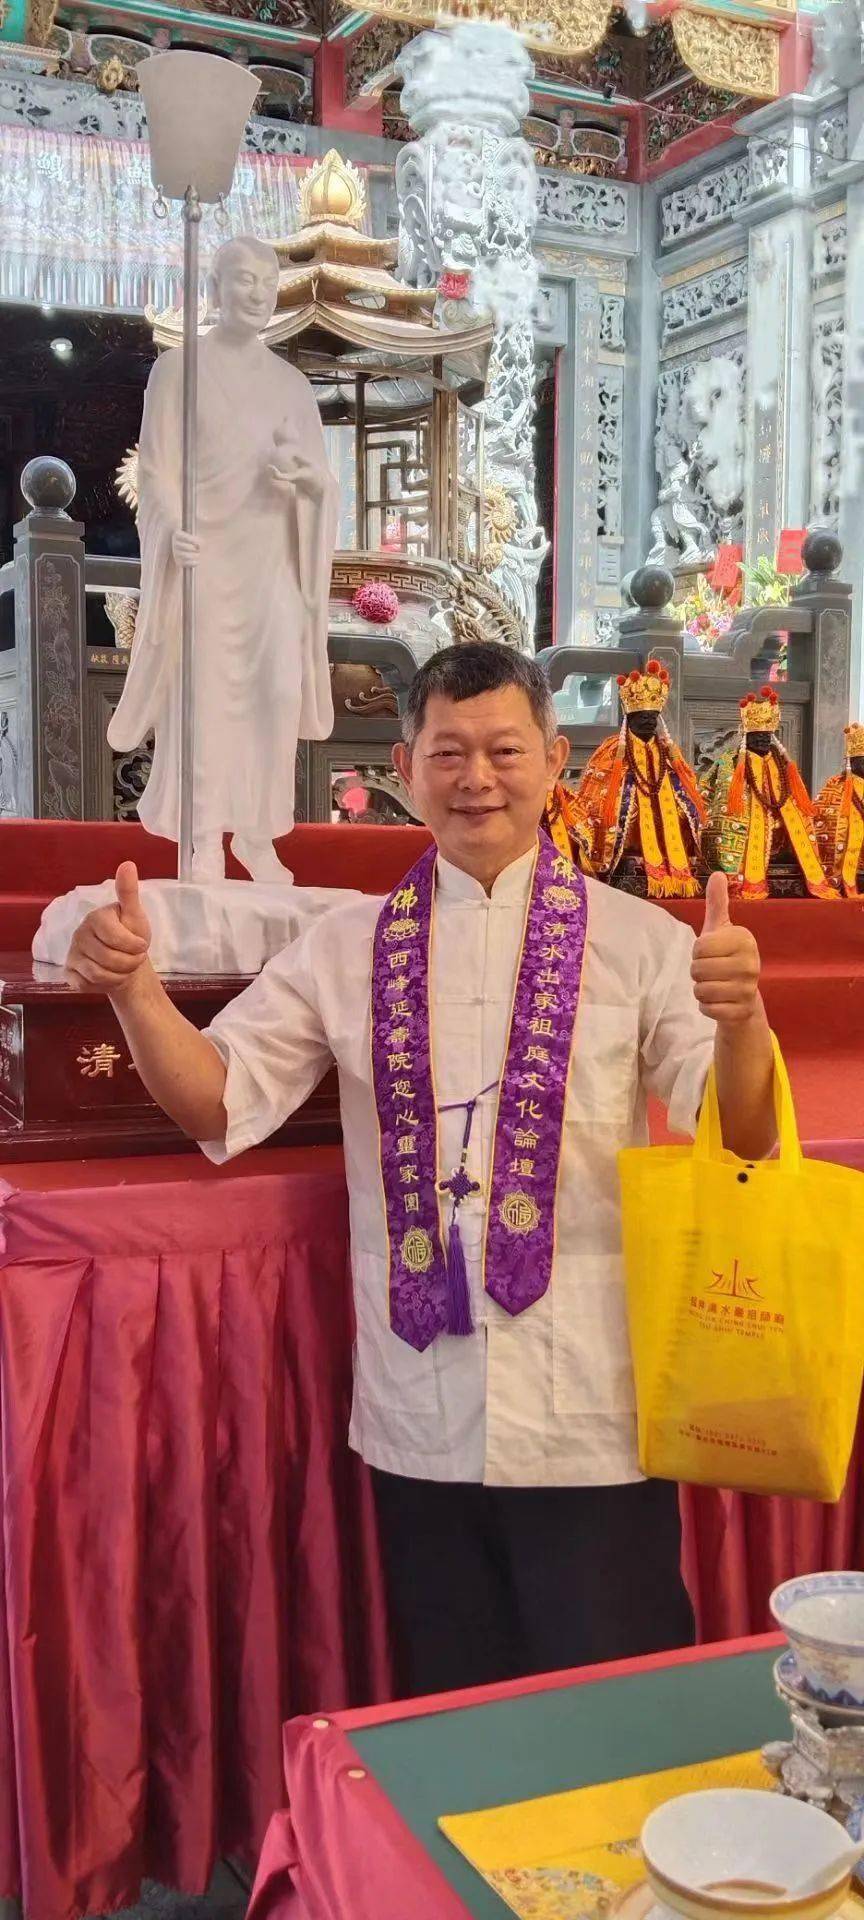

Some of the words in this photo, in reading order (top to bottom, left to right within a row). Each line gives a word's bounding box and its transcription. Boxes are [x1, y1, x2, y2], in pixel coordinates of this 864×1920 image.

[551, 856, 578, 887] 佛
[390, 883, 419, 917] 佛
[77, 1044, 136, 1078] 清
[508, 921, 568, 1178] 清水出家祖庭文化論壇
